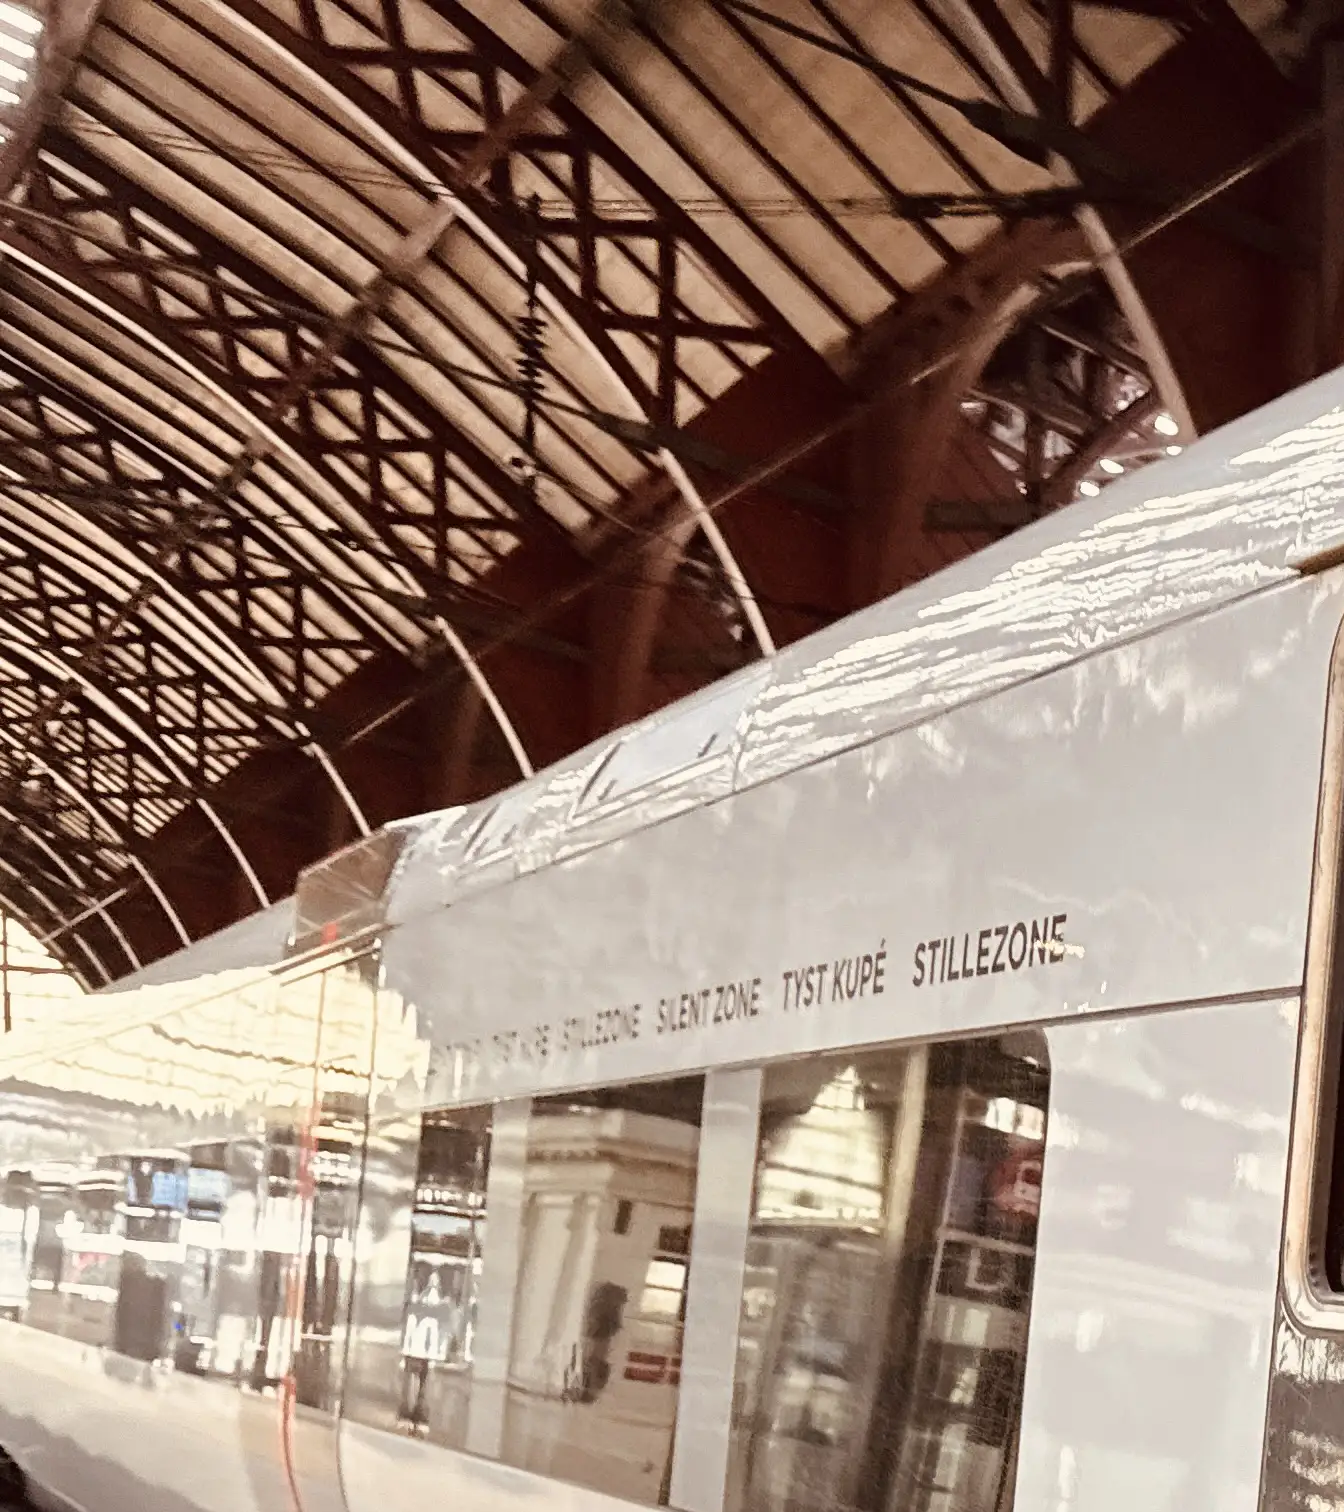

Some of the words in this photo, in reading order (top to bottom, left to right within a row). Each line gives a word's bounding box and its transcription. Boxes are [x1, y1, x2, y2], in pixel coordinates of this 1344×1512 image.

[713, 977, 762, 1024] ZONE
[782, 962, 828, 1011] TYST
[832, 937, 887, 1002] KUPÉ
[912, 913, 1068, 988] STILLEZONE
